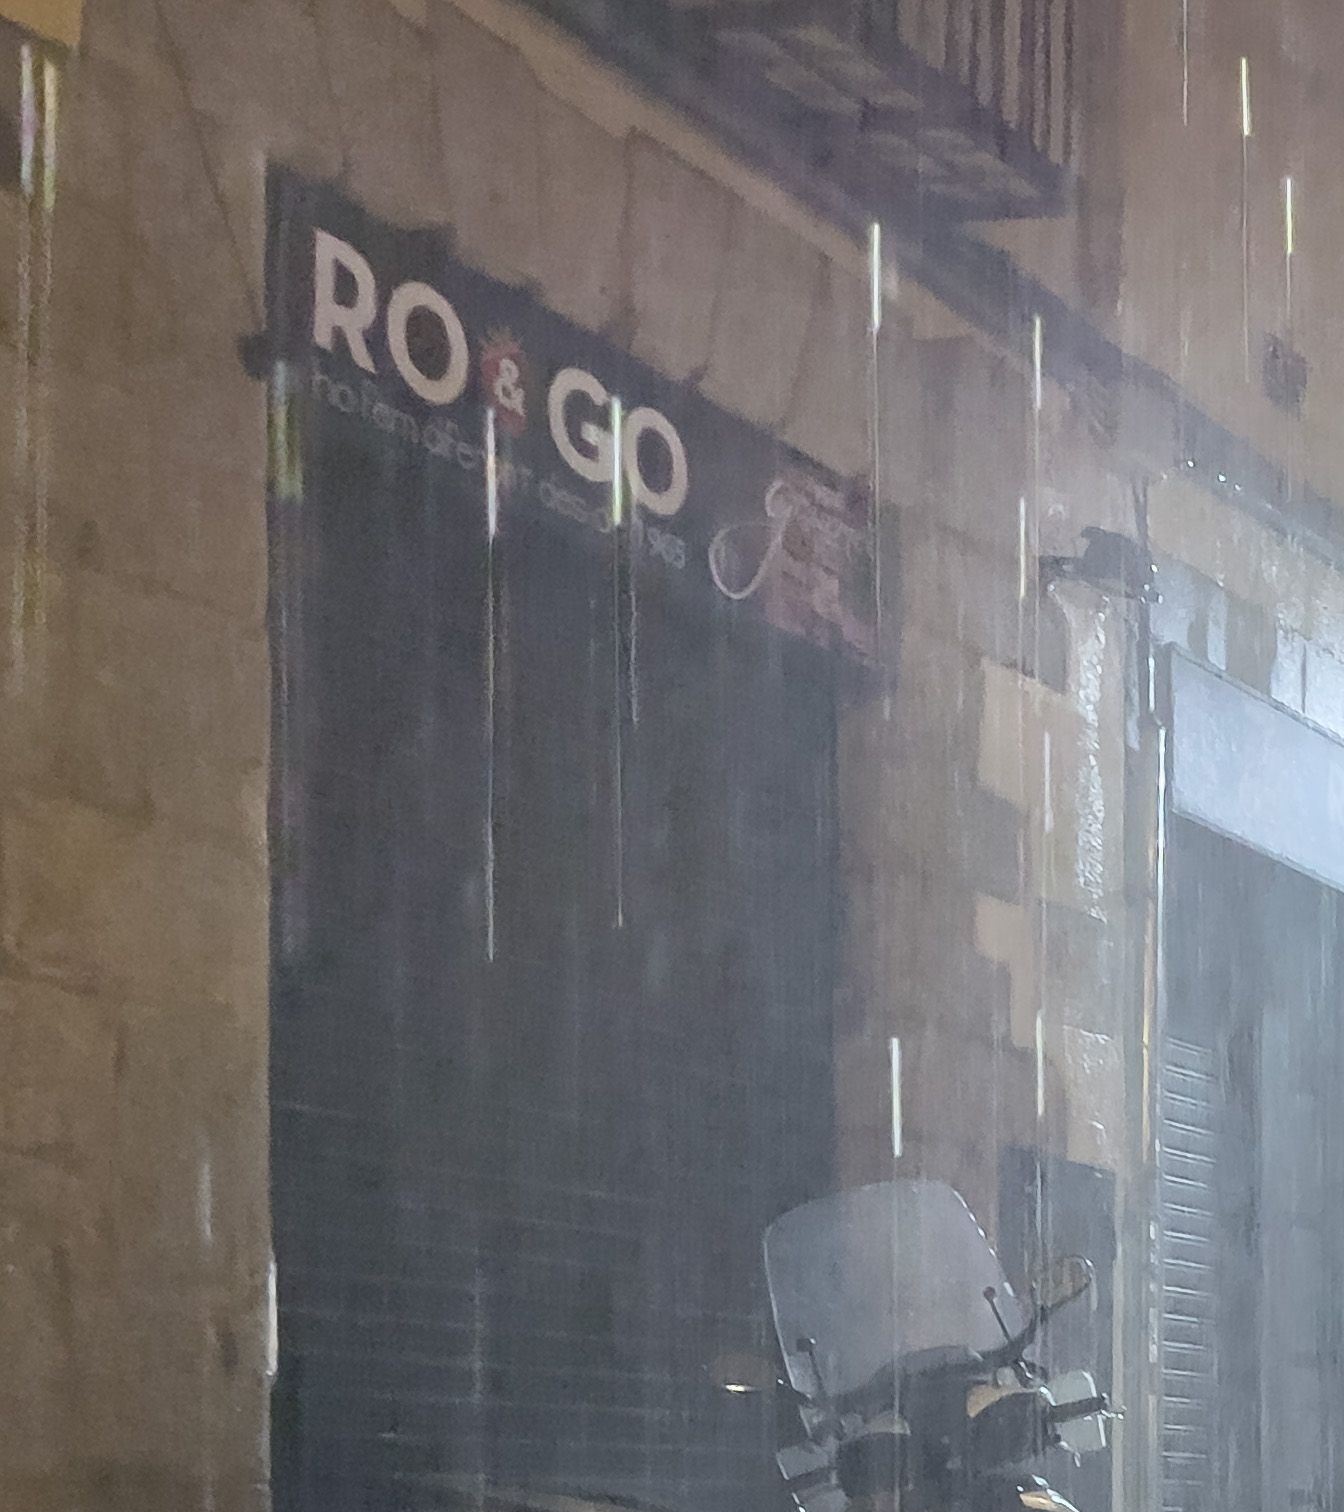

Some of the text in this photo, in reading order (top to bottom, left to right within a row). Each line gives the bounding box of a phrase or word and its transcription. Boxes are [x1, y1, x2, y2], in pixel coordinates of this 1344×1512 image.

[313, 227, 468, 405] RO
[494, 357, 526, 419] &
[548, 367, 688, 516] GO
